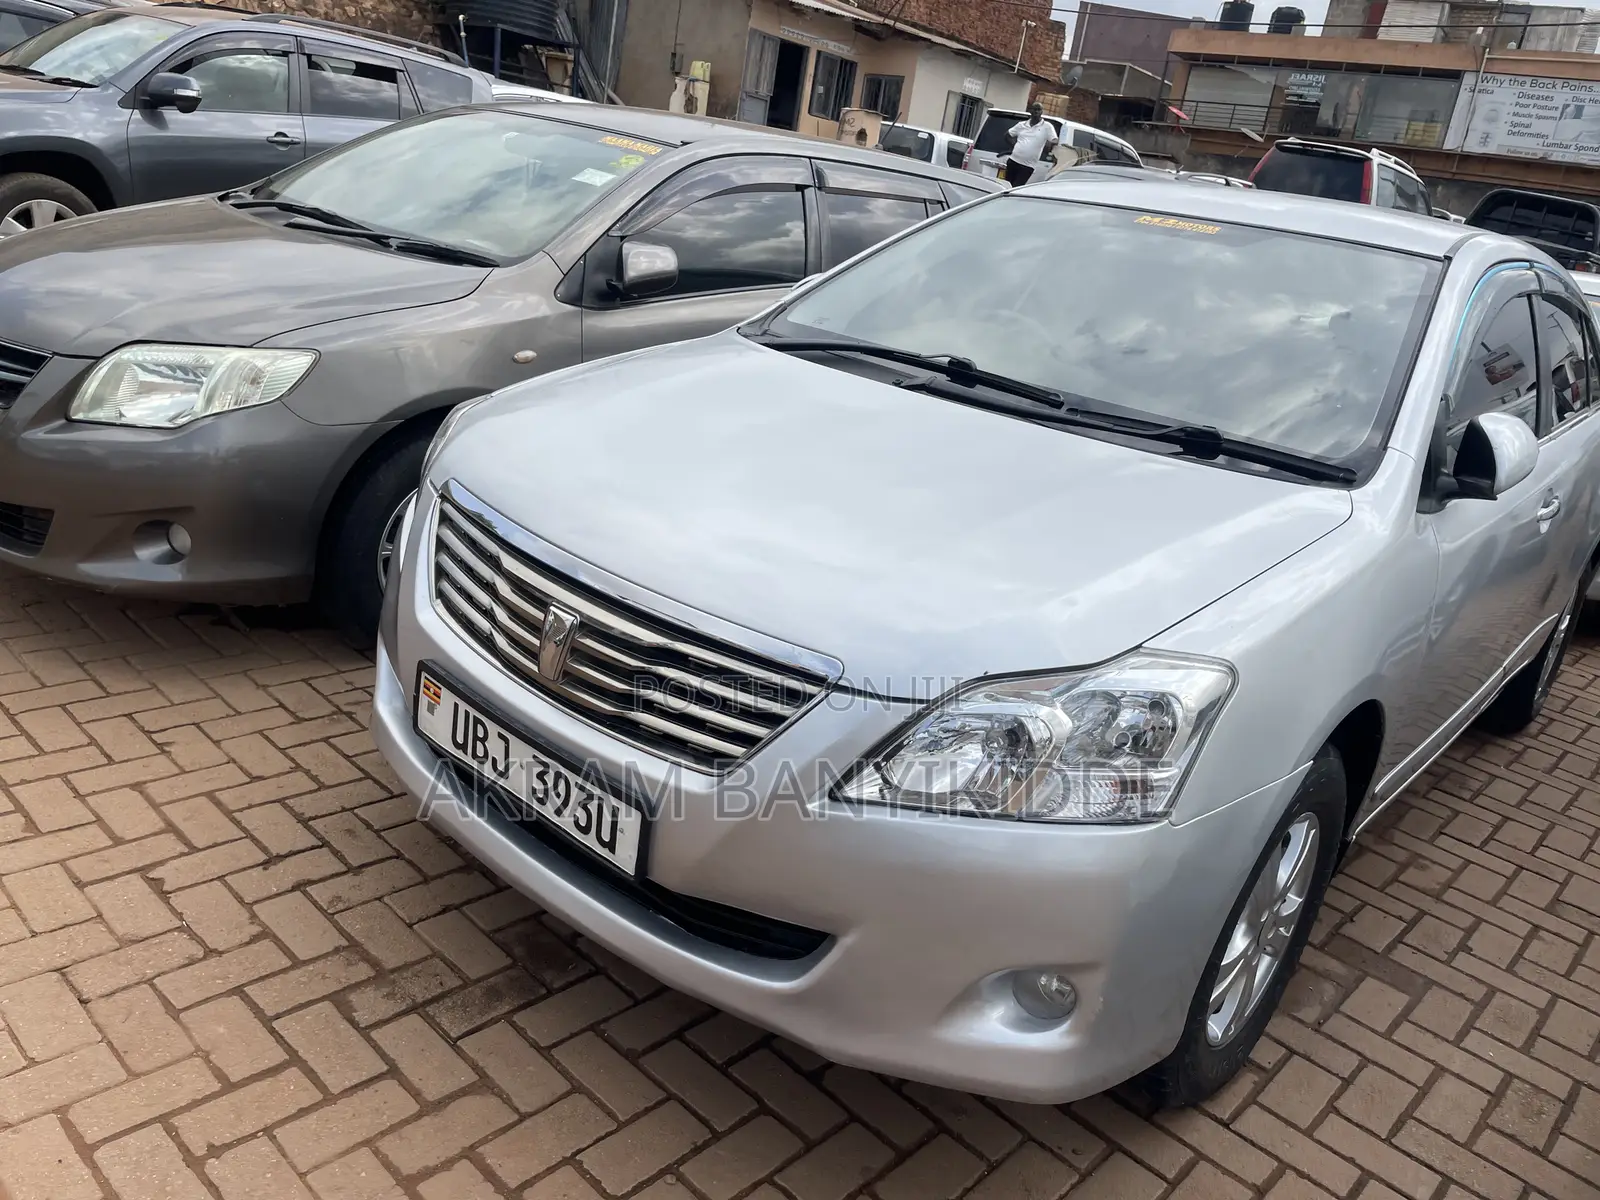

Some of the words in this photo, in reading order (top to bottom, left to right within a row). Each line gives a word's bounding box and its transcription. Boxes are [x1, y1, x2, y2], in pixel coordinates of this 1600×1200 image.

[1480, 74, 1505, 88] Why
[1508, 78, 1527, 88] the
[1529, 79, 1558, 90] Back
[1517, 91, 1555, 102] Diseases
[1571, 95, 1588, 104] Disc
[1514, 101, 1531, 109] Poor
[1532, 103, 1560, 112] Posture
[1509, 120, 1532, 129] Spinal
[1507, 129, 1549, 139] Deformities
[1541, 140, 1572, 150] Lumbar
[451, 701, 510, 780] UBJ
[531, 753, 620, 855] 393U
